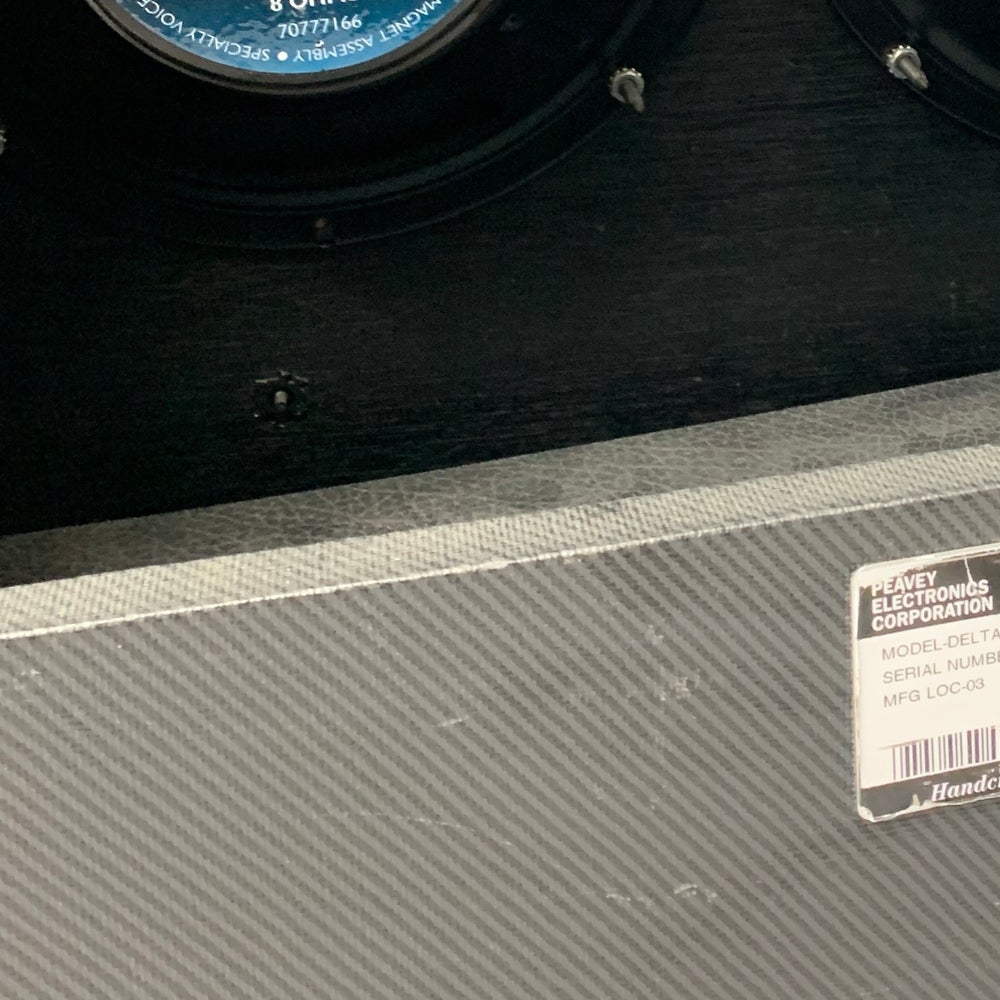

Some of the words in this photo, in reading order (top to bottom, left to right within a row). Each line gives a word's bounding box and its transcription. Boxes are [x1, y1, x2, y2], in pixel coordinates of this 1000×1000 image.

[278, 14, 362, 39] 70777166
[186, 26, 270, 62] SPECIALLY
[292, 34, 374, 62] ASSEMBLY
[871, 570, 937, 597] PEAVEY
[871, 579, 990, 615] ELECTRONICS
[871, 595, 994, 632] CORPORATION
[882, 628, 1000, 661] MODEL-DELTA
[883, 662, 941, 685] SERIAL
[883, 690, 921, 708] MFG
[927, 678, 985, 699] LOC-03
